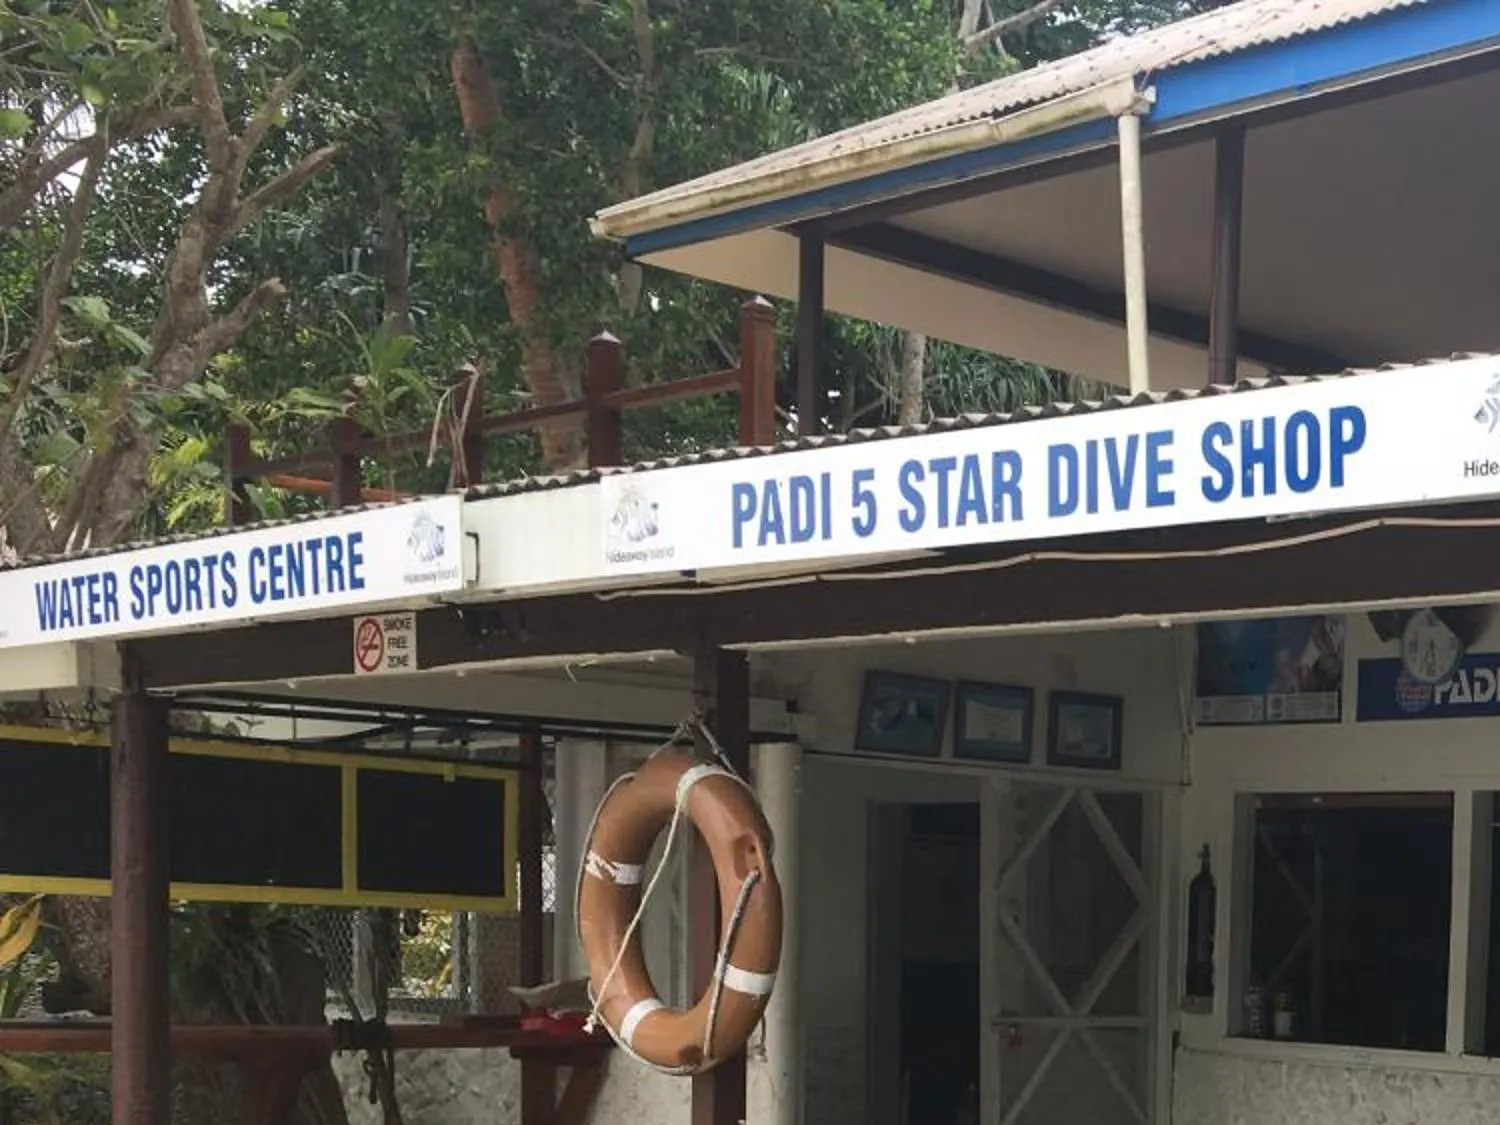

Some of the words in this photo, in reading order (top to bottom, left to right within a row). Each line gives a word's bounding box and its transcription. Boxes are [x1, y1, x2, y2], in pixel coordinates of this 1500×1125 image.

[731, 471, 833, 549] PADI
[851, 467, 878, 538] 5
[898, 448, 1024, 534] STAR
[1047, 429, 1175, 516] DIVE
[1200, 404, 1367, 503] SHOP
[35, 572, 119, 631] WATER
[130, 550, 238, 620] SPORTS
[248, 531, 366, 604] CENTRE
[383, 617, 412, 631] SMOKE
[387, 636, 410, 649] FREE
[387, 654, 409, 668] ZONE
